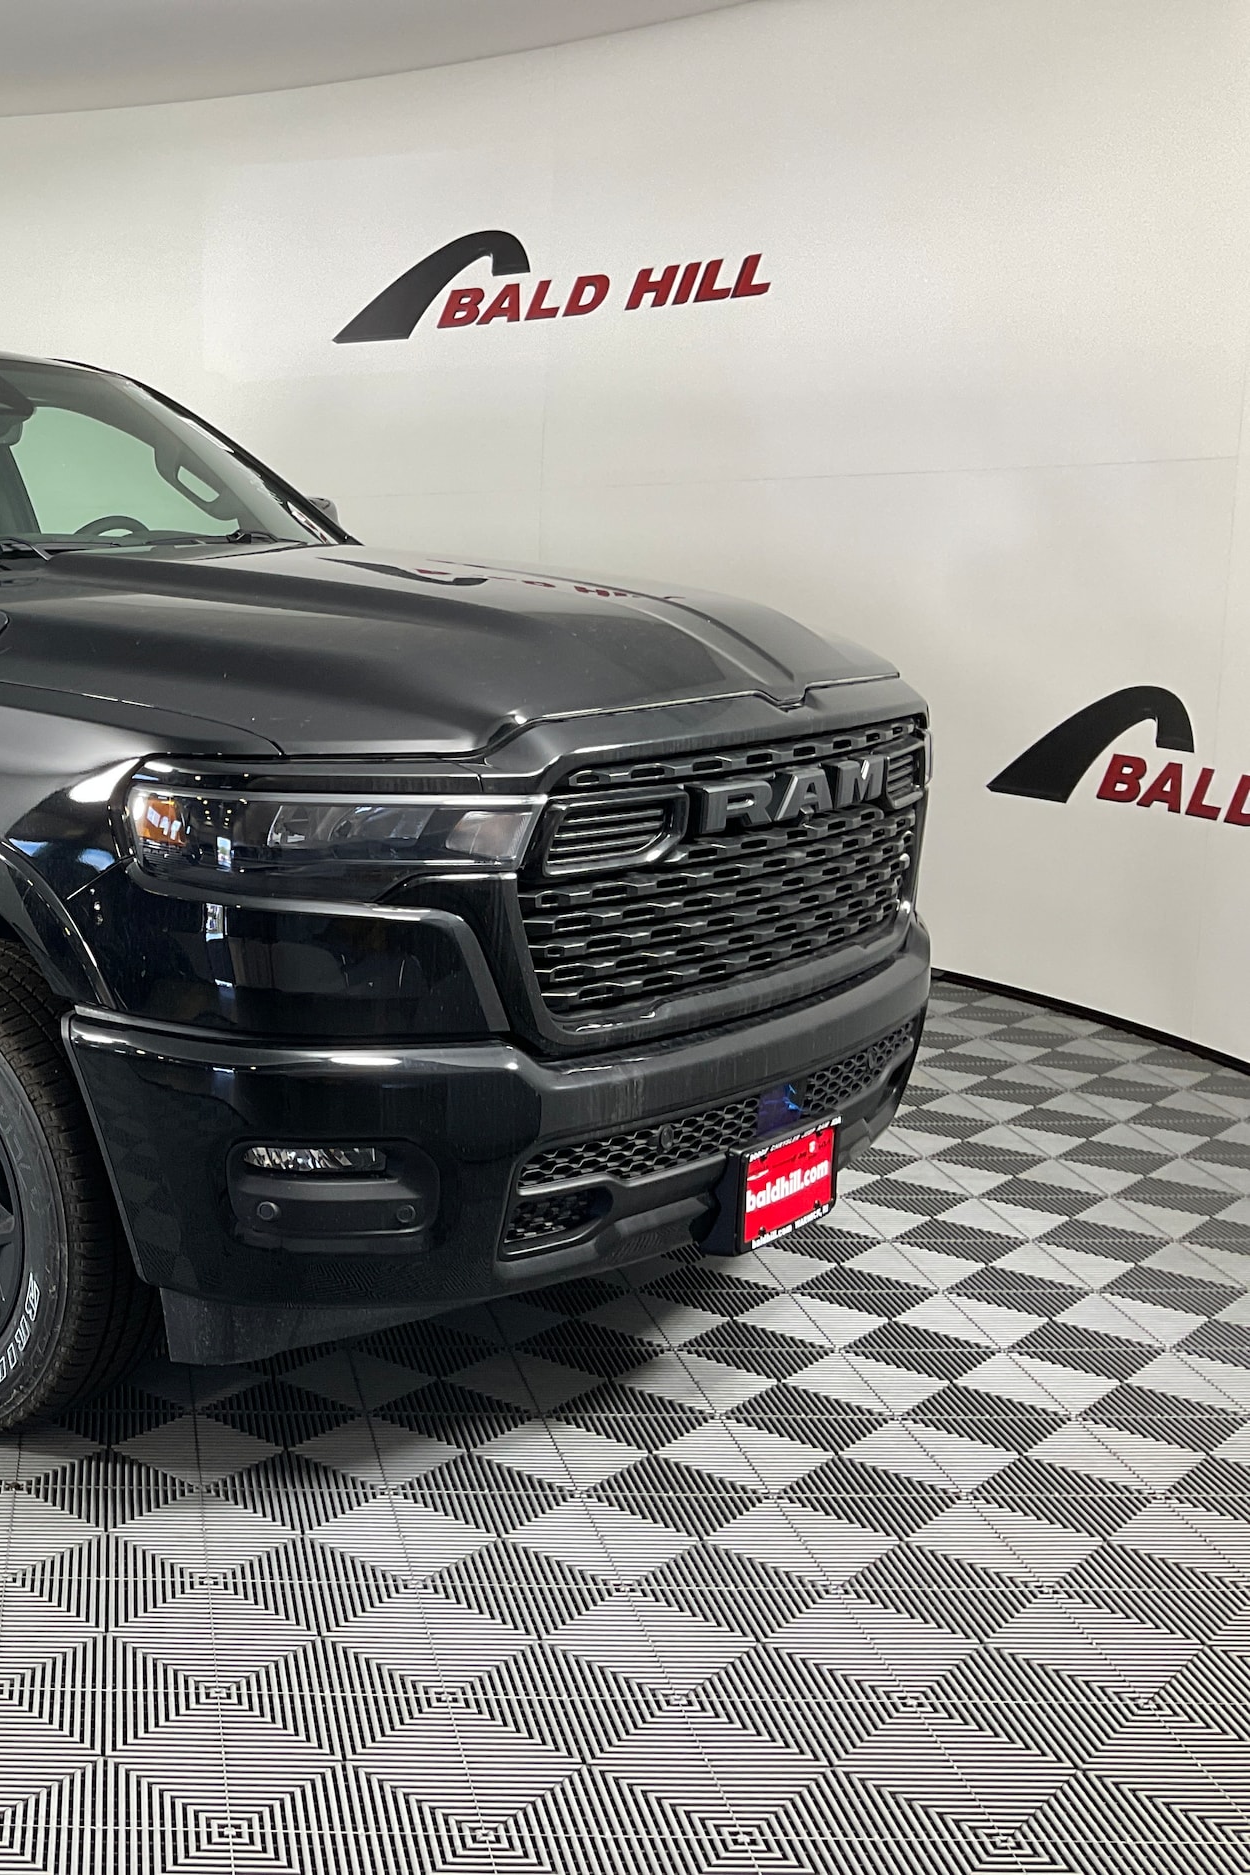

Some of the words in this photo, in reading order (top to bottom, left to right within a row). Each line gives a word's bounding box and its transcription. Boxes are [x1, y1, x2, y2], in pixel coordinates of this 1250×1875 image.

[437, 274, 610, 329] BALD
[624, 253, 771, 311] HILL
[695, 754, 888, 835] RAM
[745, 1159, 829, 1213] baldhill.com
